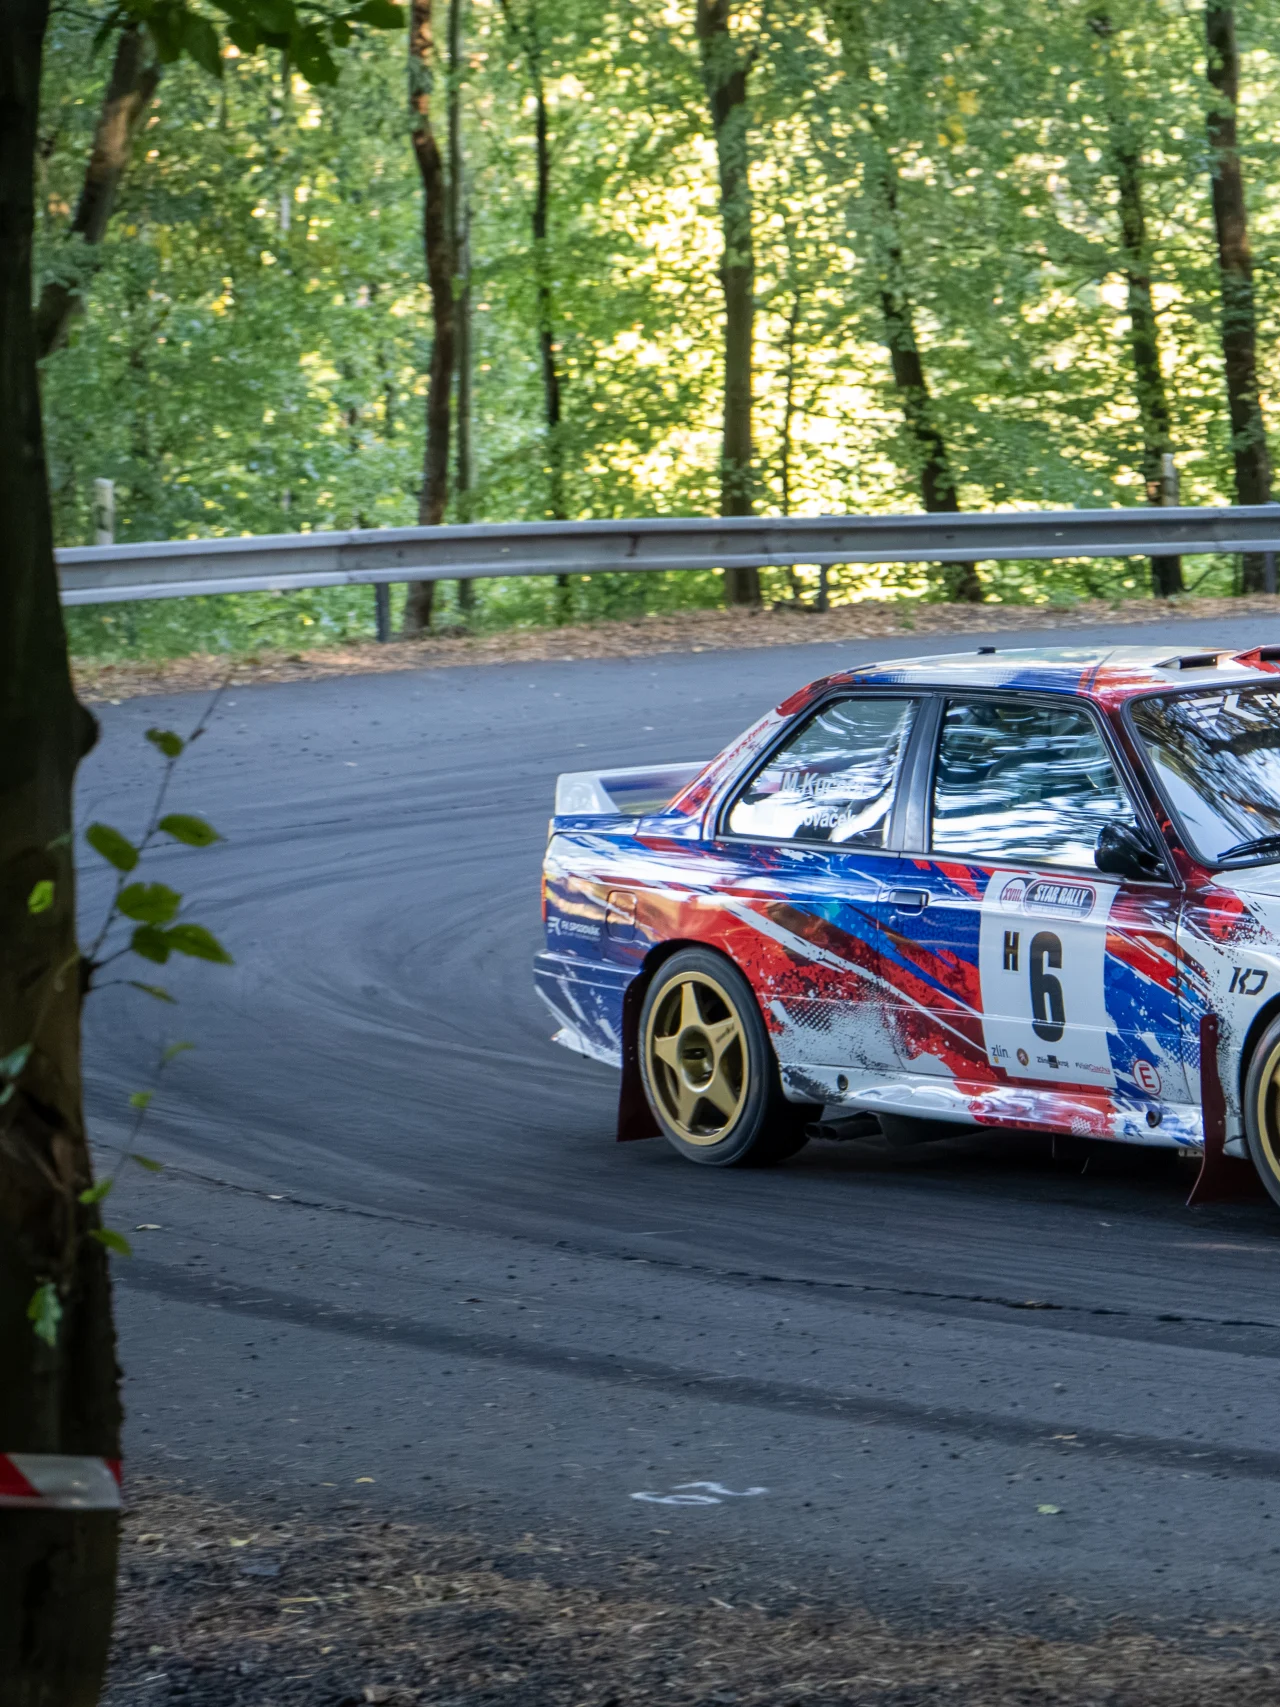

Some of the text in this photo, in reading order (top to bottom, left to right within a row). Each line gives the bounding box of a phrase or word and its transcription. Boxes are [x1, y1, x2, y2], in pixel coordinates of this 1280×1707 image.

[1034, 884, 1089, 907] STAR RALLY
[1003, 930, 1066, 1043] H 6
[1138, 1066, 1156, 1088] E
